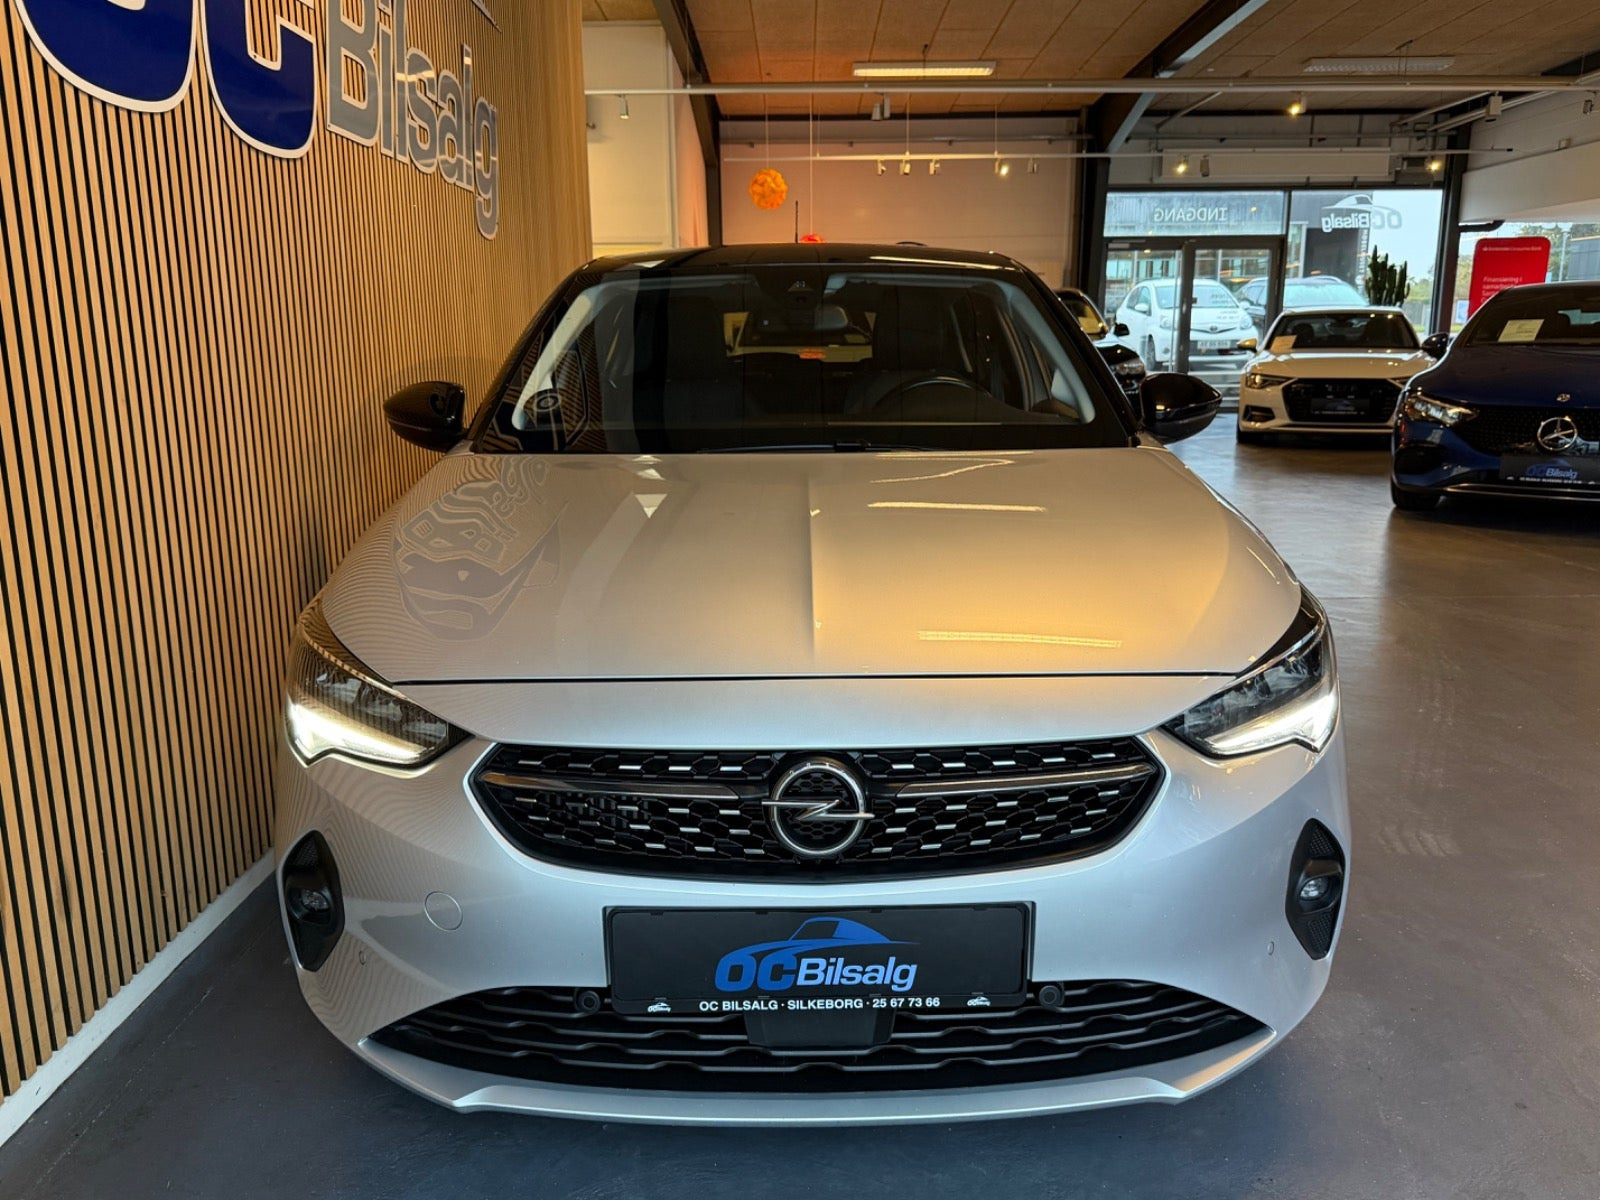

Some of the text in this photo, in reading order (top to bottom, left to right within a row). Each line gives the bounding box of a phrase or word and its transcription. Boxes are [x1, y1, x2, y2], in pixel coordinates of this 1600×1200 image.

[699, 998, 940, 1012] OC BILSALG SILKEBORG 25 67 73 66
